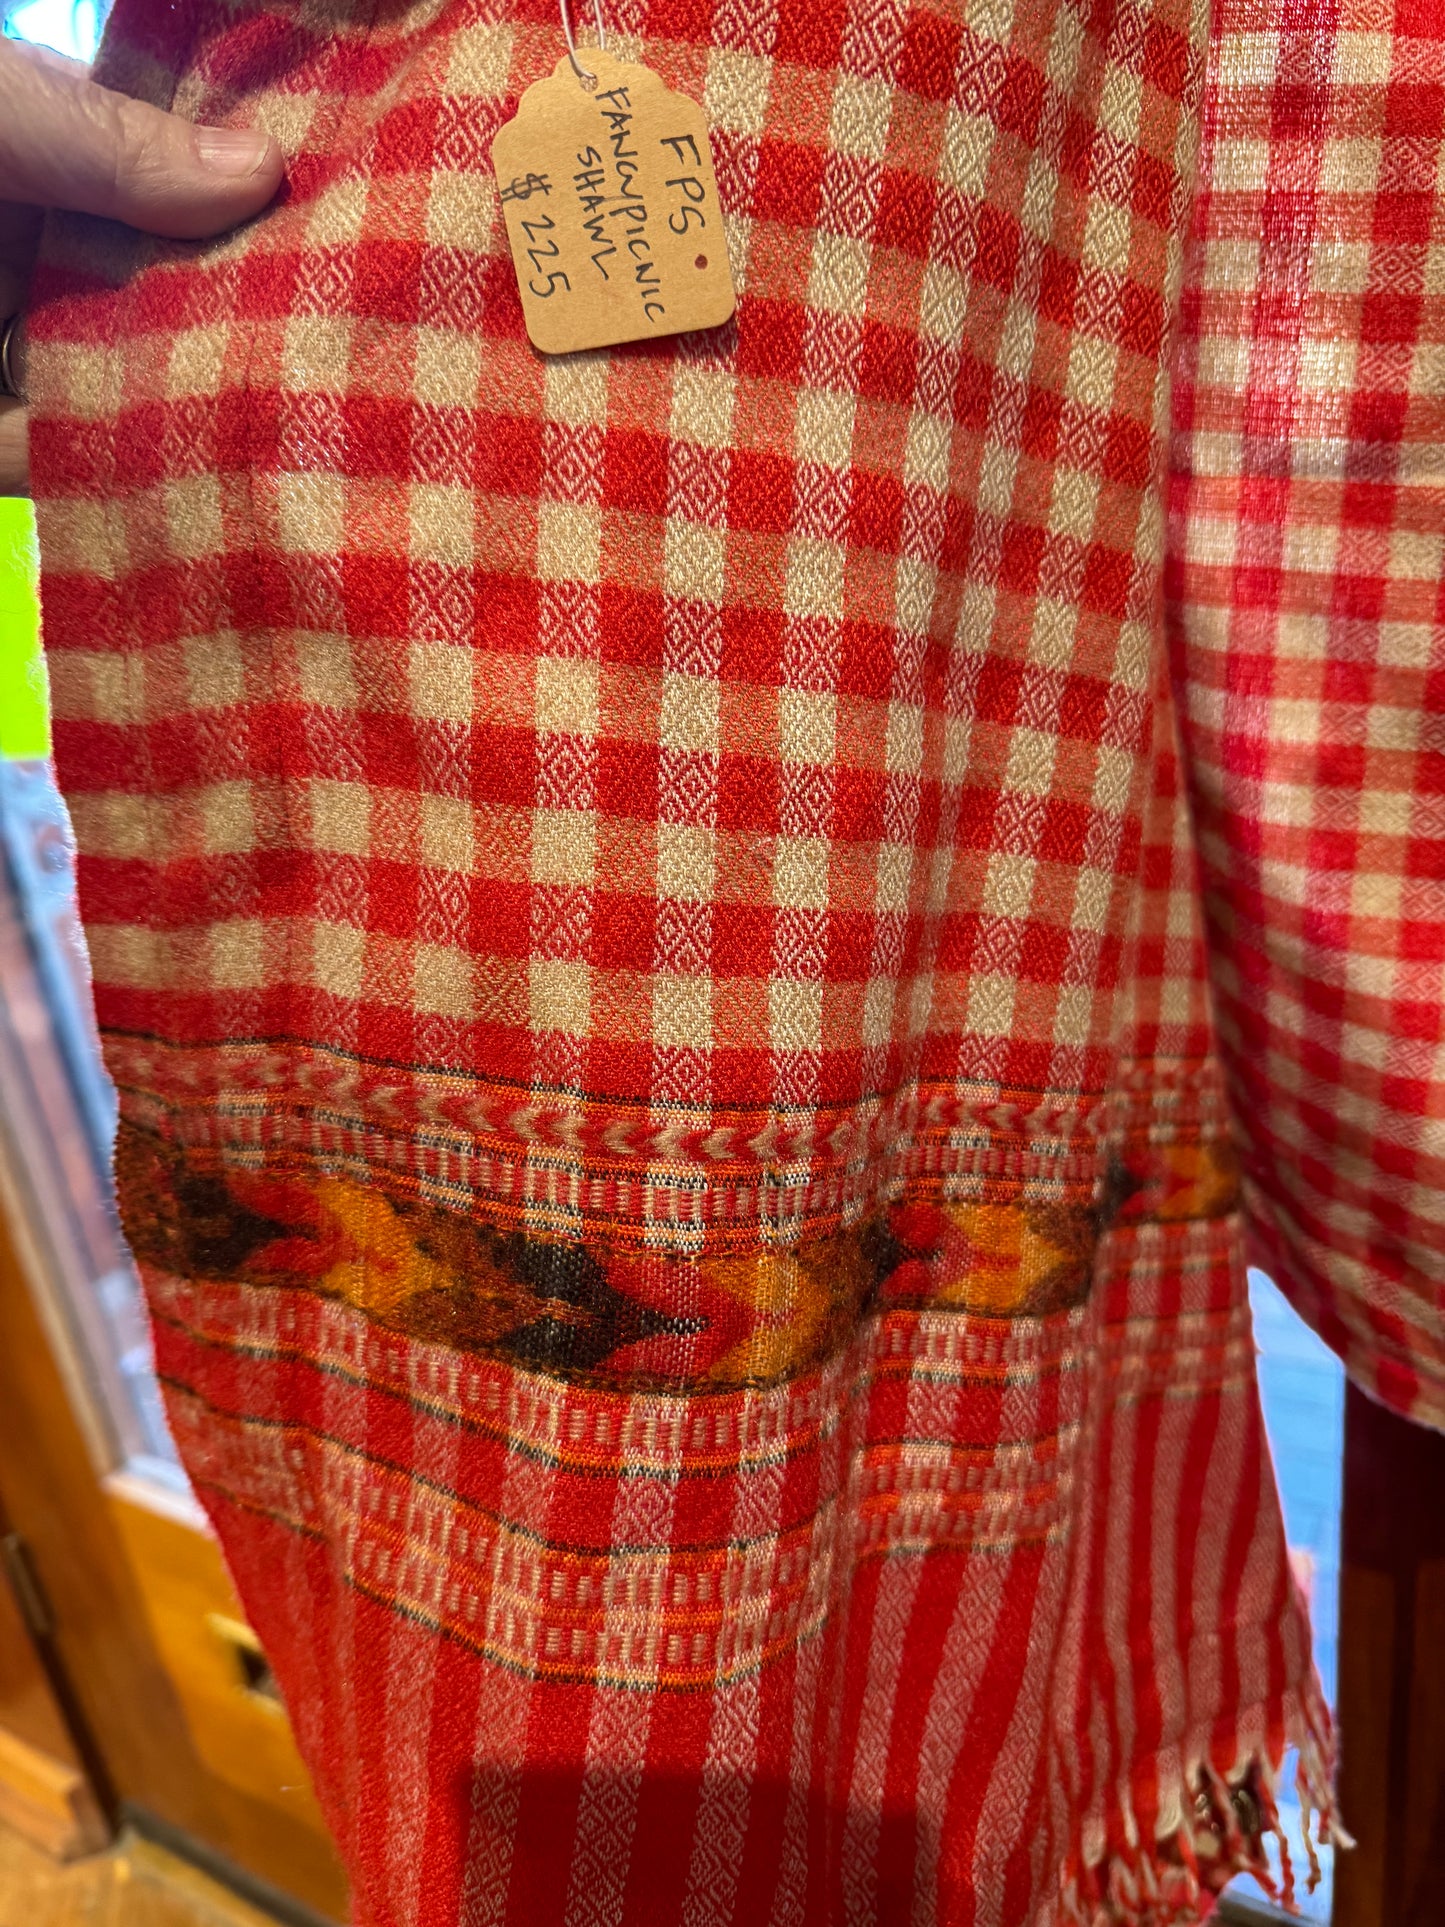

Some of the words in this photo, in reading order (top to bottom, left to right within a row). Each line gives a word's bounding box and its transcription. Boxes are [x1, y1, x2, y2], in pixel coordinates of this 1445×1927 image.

[572, 145, 618, 281] SHAWL
[660, 134, 707, 236] FPS
[608, 204, 666, 323] PICNIC
